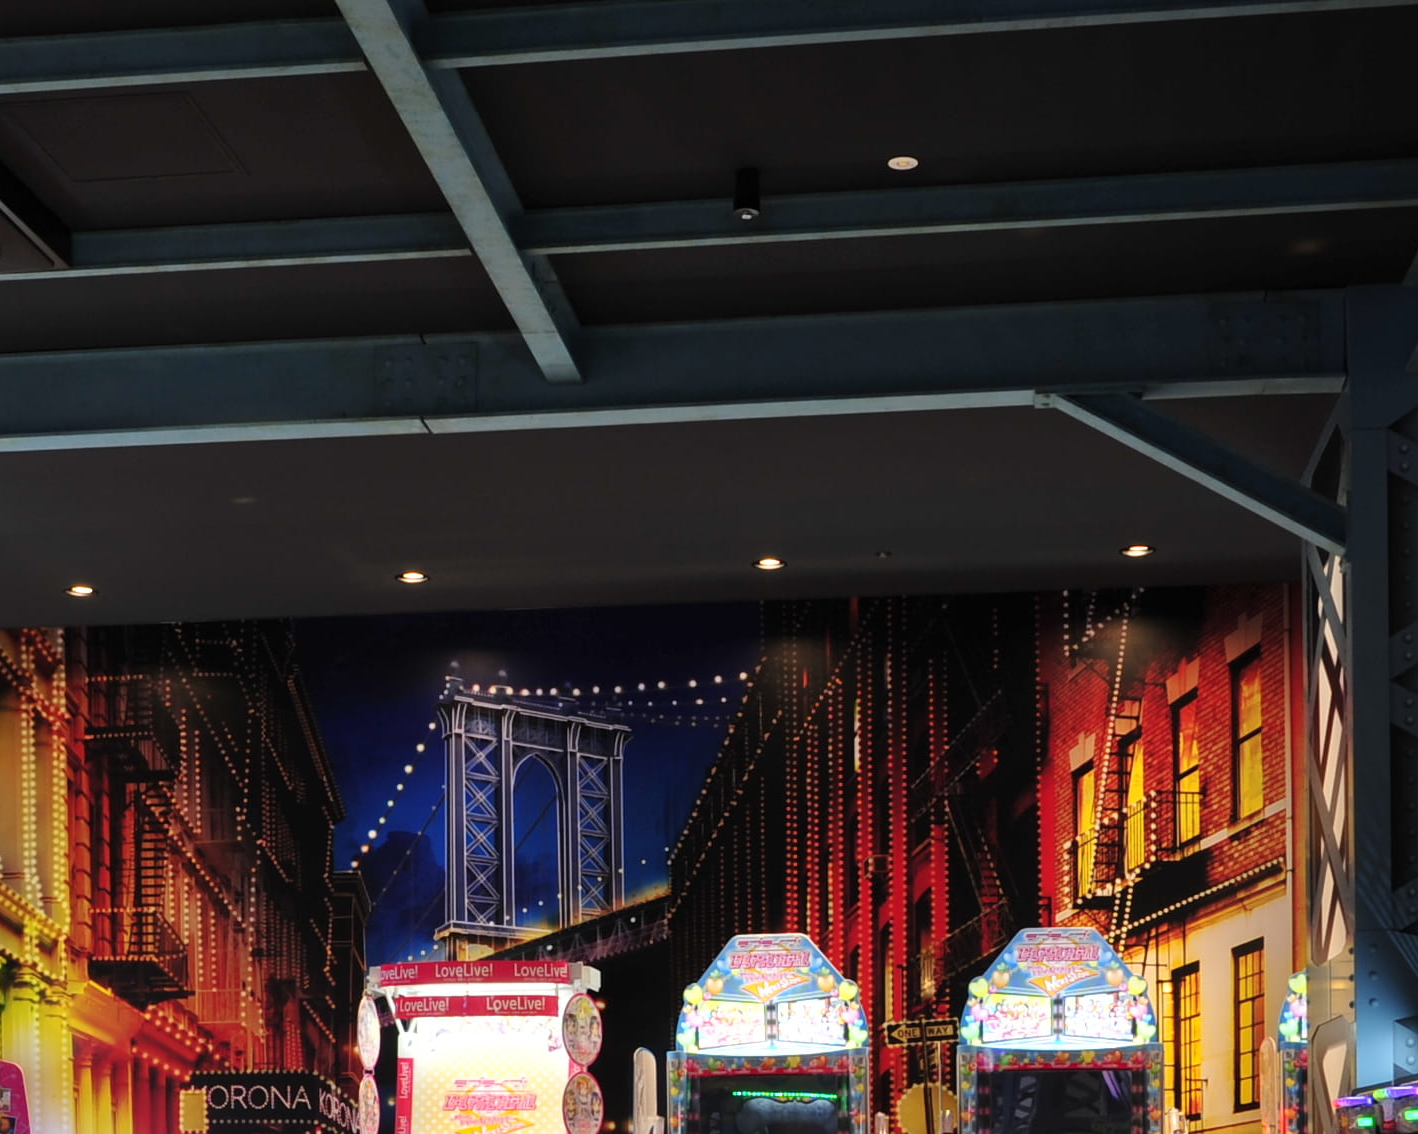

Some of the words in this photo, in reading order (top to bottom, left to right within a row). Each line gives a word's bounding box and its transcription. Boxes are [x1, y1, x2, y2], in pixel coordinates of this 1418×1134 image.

[435, 963, 494, 978] LoveLive!
[513, 963, 568, 978] LoveLive!
[399, 998, 450, 1013] LoveLive!
[486, 997, 546, 1013] LoveLive!
[897, 1027, 919, 1038] ONE
[927, 1025, 949, 1036] WAY
[399, 1061, 410, 1099] LoveLive!
